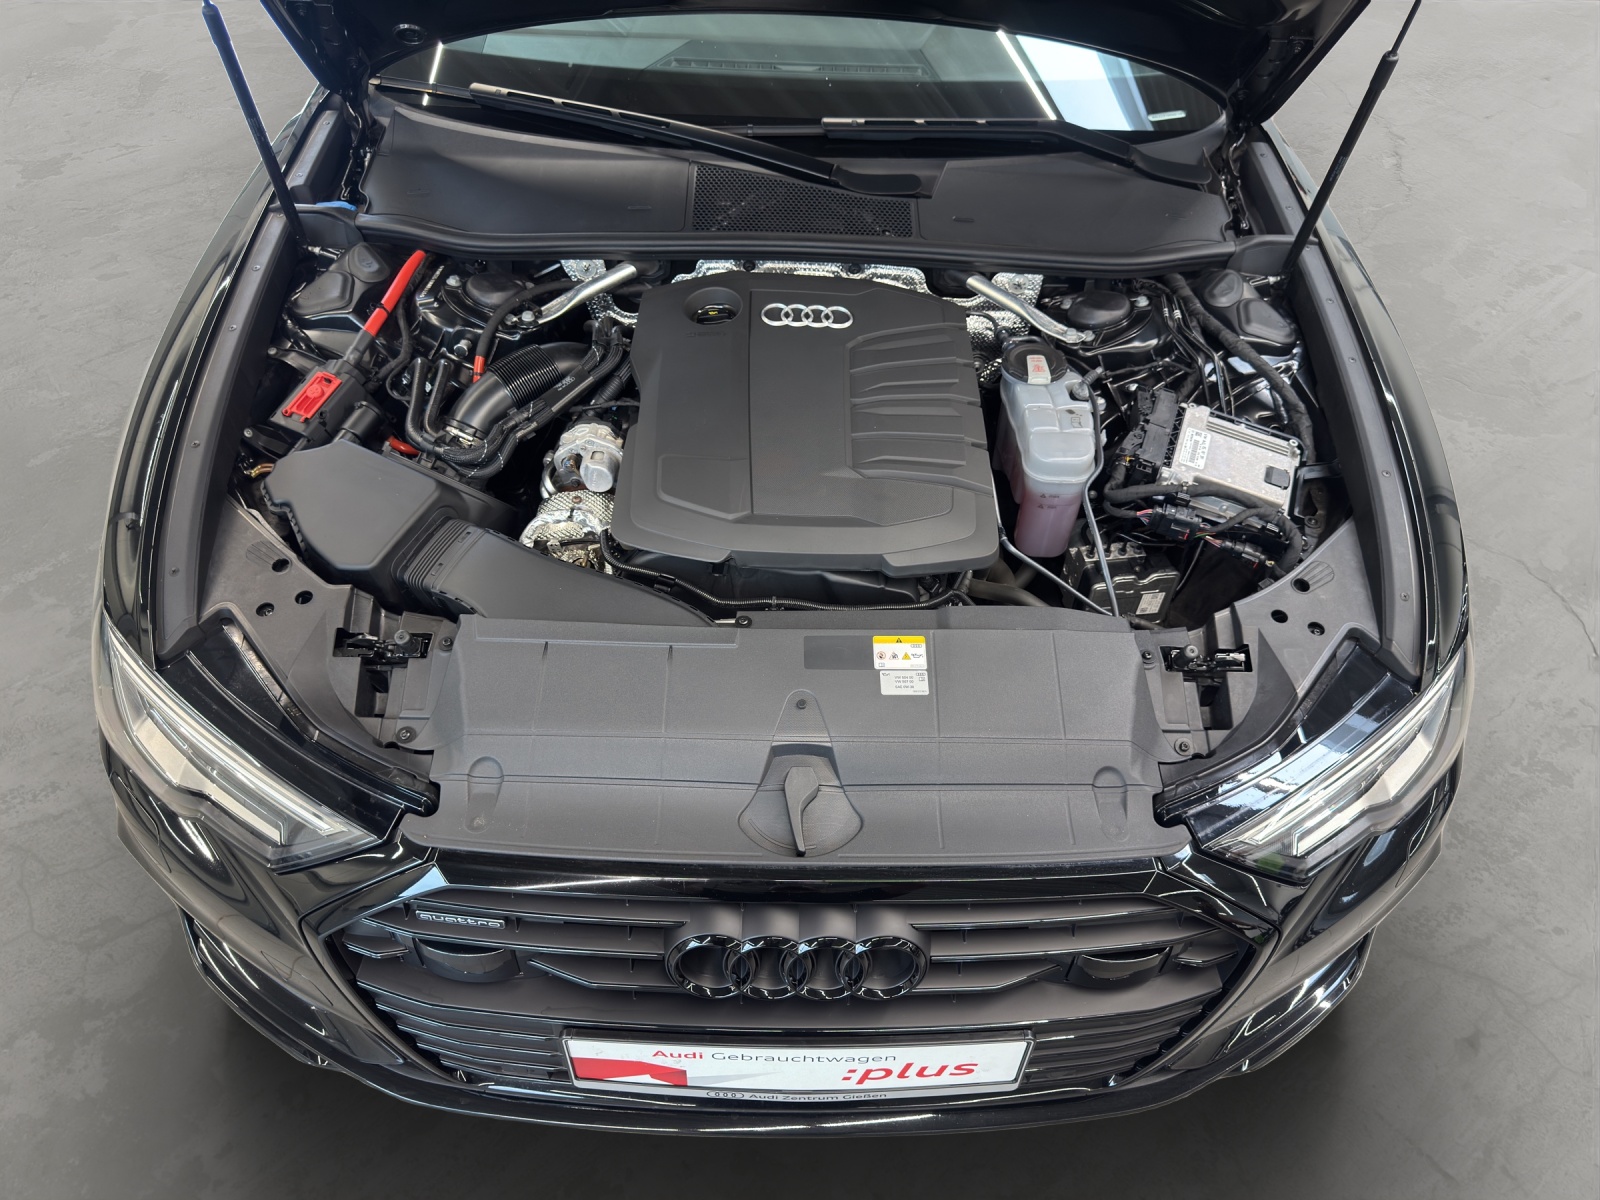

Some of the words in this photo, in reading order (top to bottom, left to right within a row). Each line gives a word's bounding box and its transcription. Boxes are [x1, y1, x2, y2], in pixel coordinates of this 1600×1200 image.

[419, 913, 501, 928] quattro
[652, 1050, 704, 1060] Audi
[711, 1052, 897, 1065] Gebrauchtwagen
[841, 1062, 979, 1086] :plus
